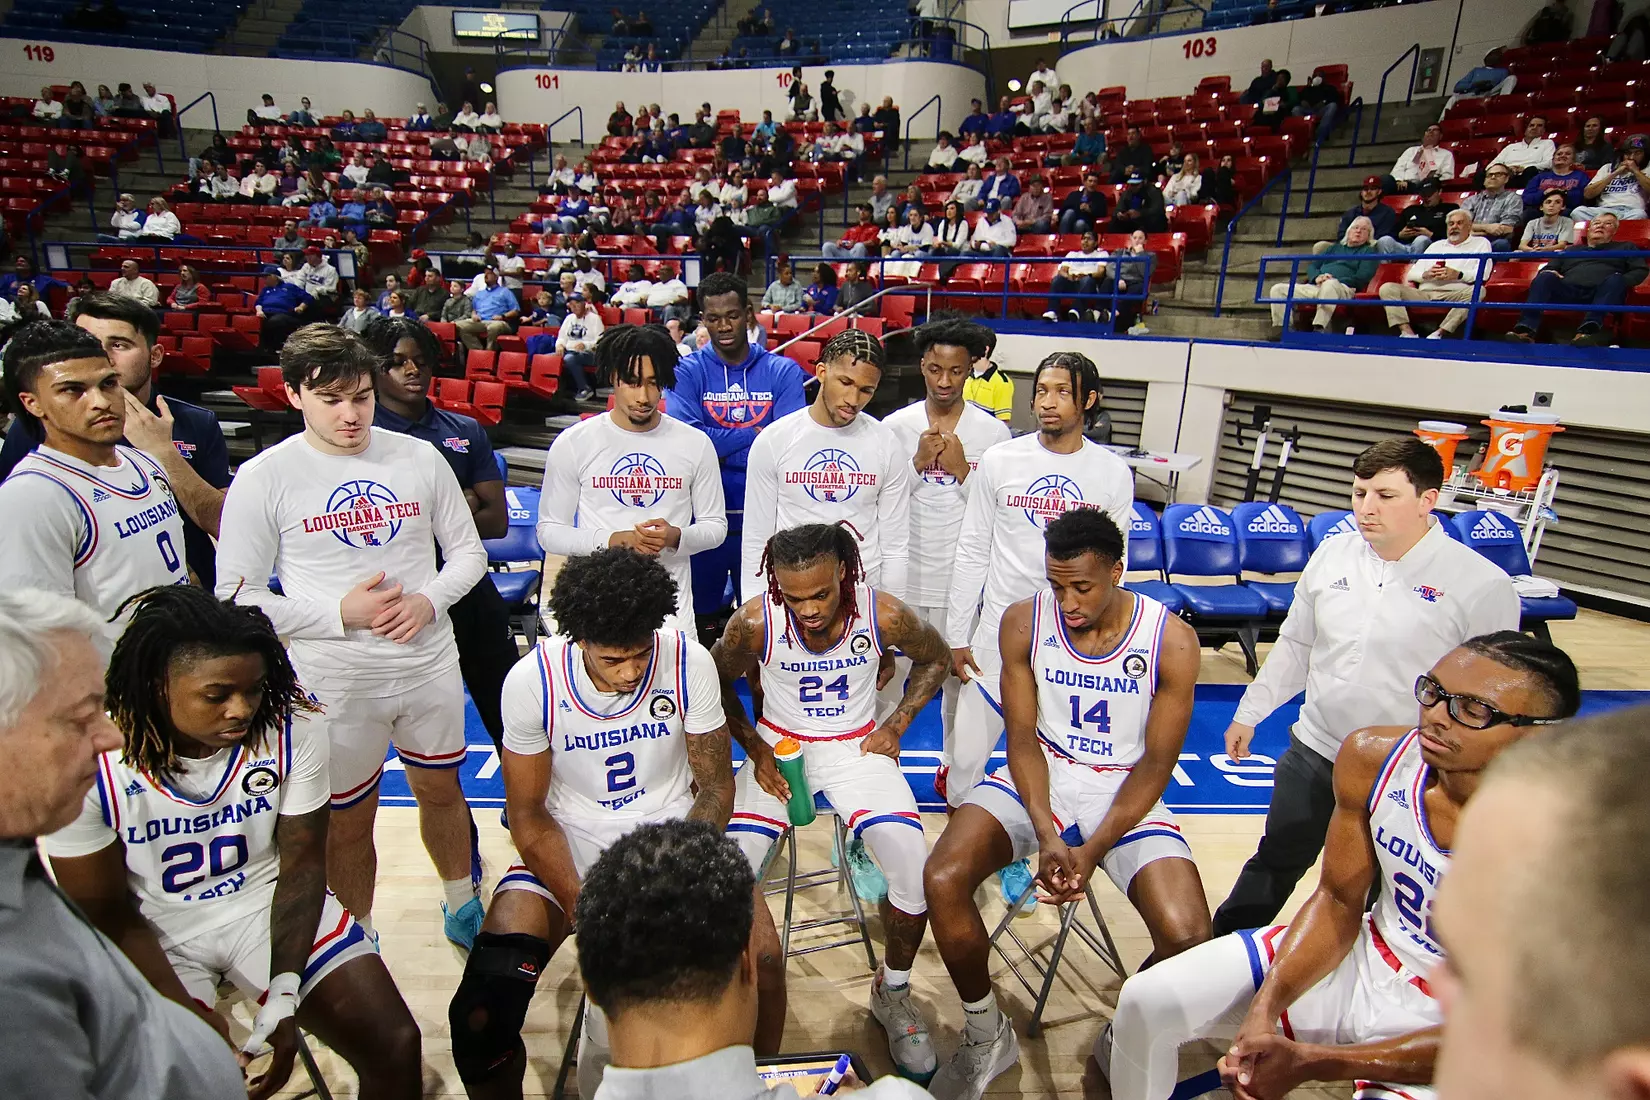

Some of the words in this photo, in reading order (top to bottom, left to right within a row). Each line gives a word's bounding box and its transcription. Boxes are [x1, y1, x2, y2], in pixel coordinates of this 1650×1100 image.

[23, 44, 55, 63] 119
[1183, 37, 1217, 59] 103
[535, 74, 559, 89] 101
[776, 73, 793, 88] 10
[1498, 432, 1524, 457] G
[592, 476, 651, 489] LOUISIANA
[655, 477, 682, 489] TECH
[785, 471, 846, 484] LOUISIANA
[848, 473, 877, 485] TECH
[1006, 495, 1067, 513] LOUISIANA
[113, 498, 178, 539] LOUISIAN
[302, 507, 385, 533] LOUISIANA
[385, 501, 421, 520] TECH
[347, 521, 389, 533] BASKETBALL
[1179, 520, 1230, 536] adidas
[1248, 521, 1298, 533] adidas
[1470, 528, 1515, 540] adidas
[156, 530, 180, 573] 0
[780, 655, 868, 672] LOUISIANA
[799, 674, 849, 703] 24
[1044, 667, 1140, 695] LOUISIANA
[803, 704, 846, 717] TECH
[1069, 695, 1111, 734] 14
[564, 721, 671, 752] LOUISIANA
[1066, 734, 1113, 757] TECH
[605, 751, 637, 793] 2
[127, 796, 273, 845] LOUISIANA
[161, 833, 249, 894] 20
